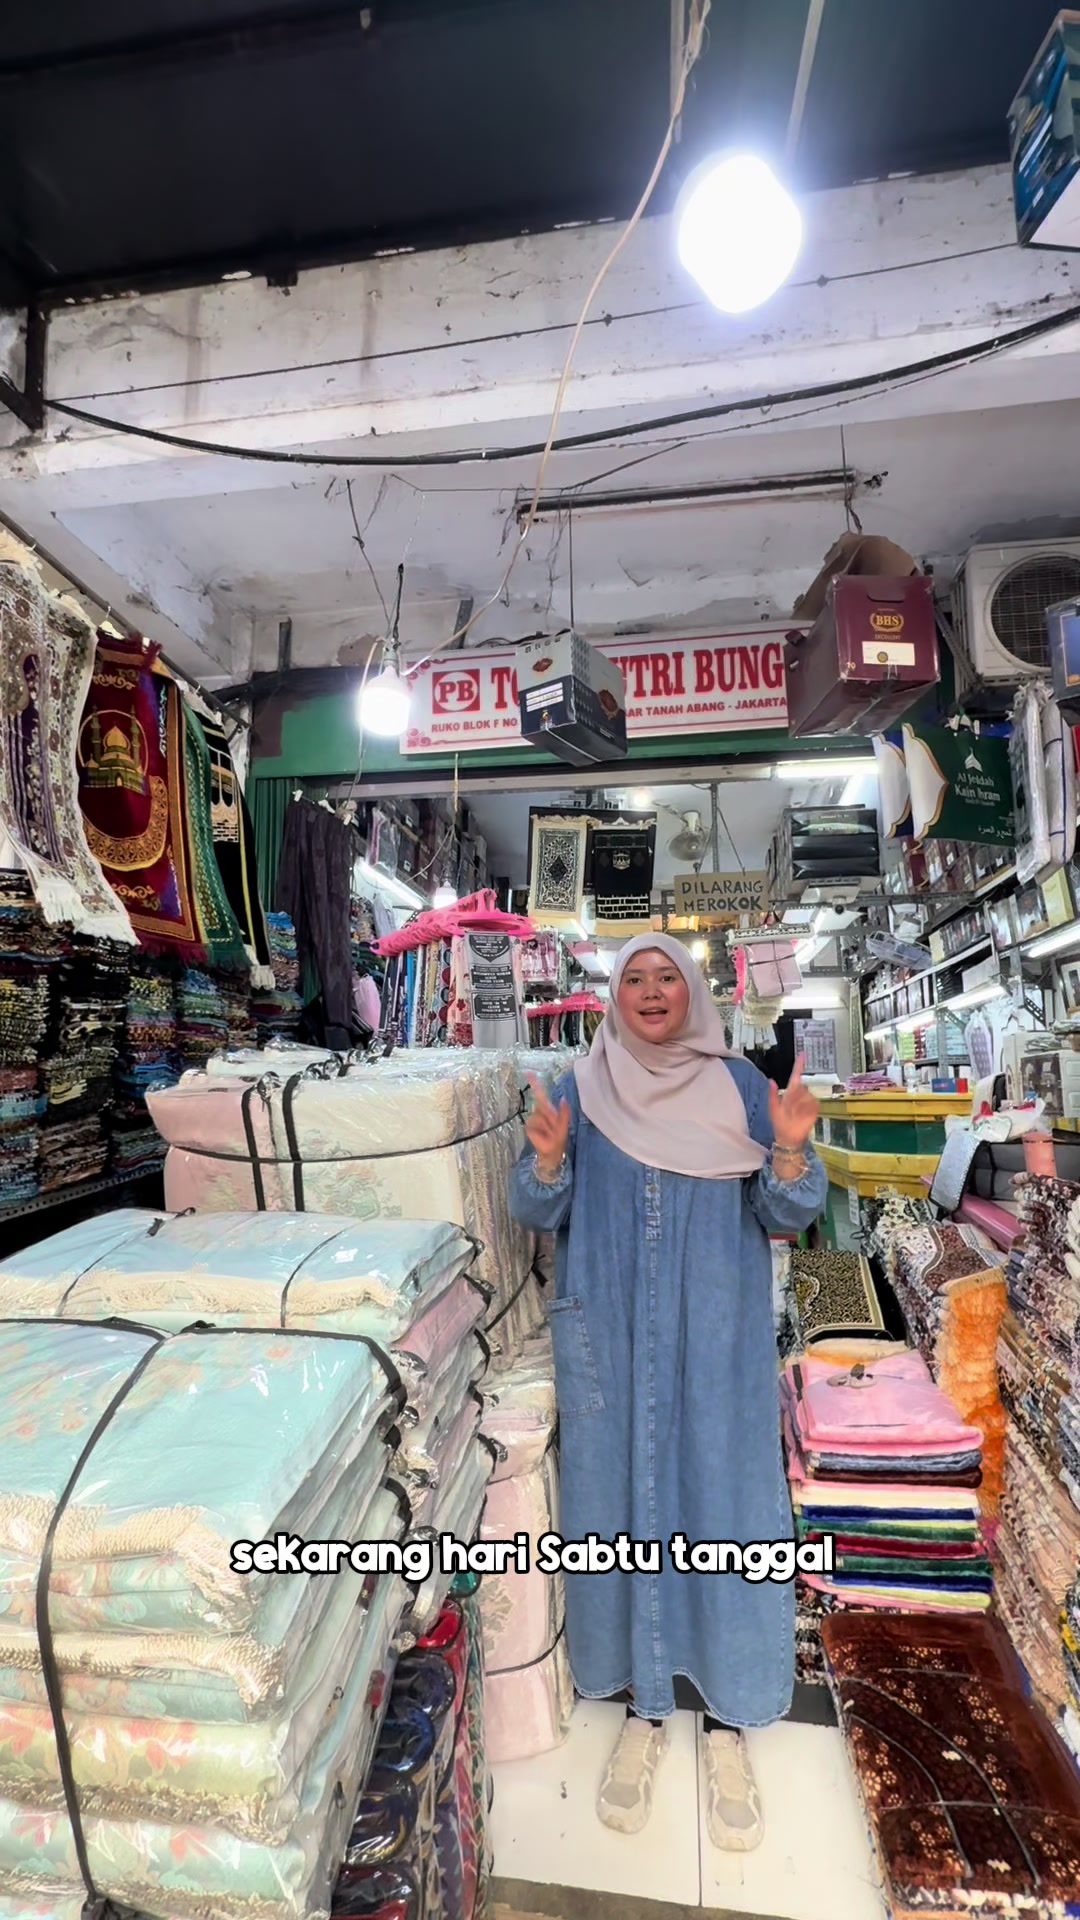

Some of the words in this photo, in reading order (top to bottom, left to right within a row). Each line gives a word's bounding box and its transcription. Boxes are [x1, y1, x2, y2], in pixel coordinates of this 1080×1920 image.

[876, 615, 900, 626] BHS
[438, 680, 475, 703] PB
[431, 722, 460, 732] RUKO
[463, 719, 491, 730] BLOK
[493, 719, 500, 728] F
[502, 717, 518, 727] NO
[647, 704, 683, 716] TANAH
[687, 700, 725, 713] ABANG
[735, 696, 787, 710] JAKARTA
[954, 783, 976, 798] Kain
[977, 786, 1001, 801] Ihram
[682, 880, 764, 894] DILARANG
[683, 895, 763, 912] MEROKOK
